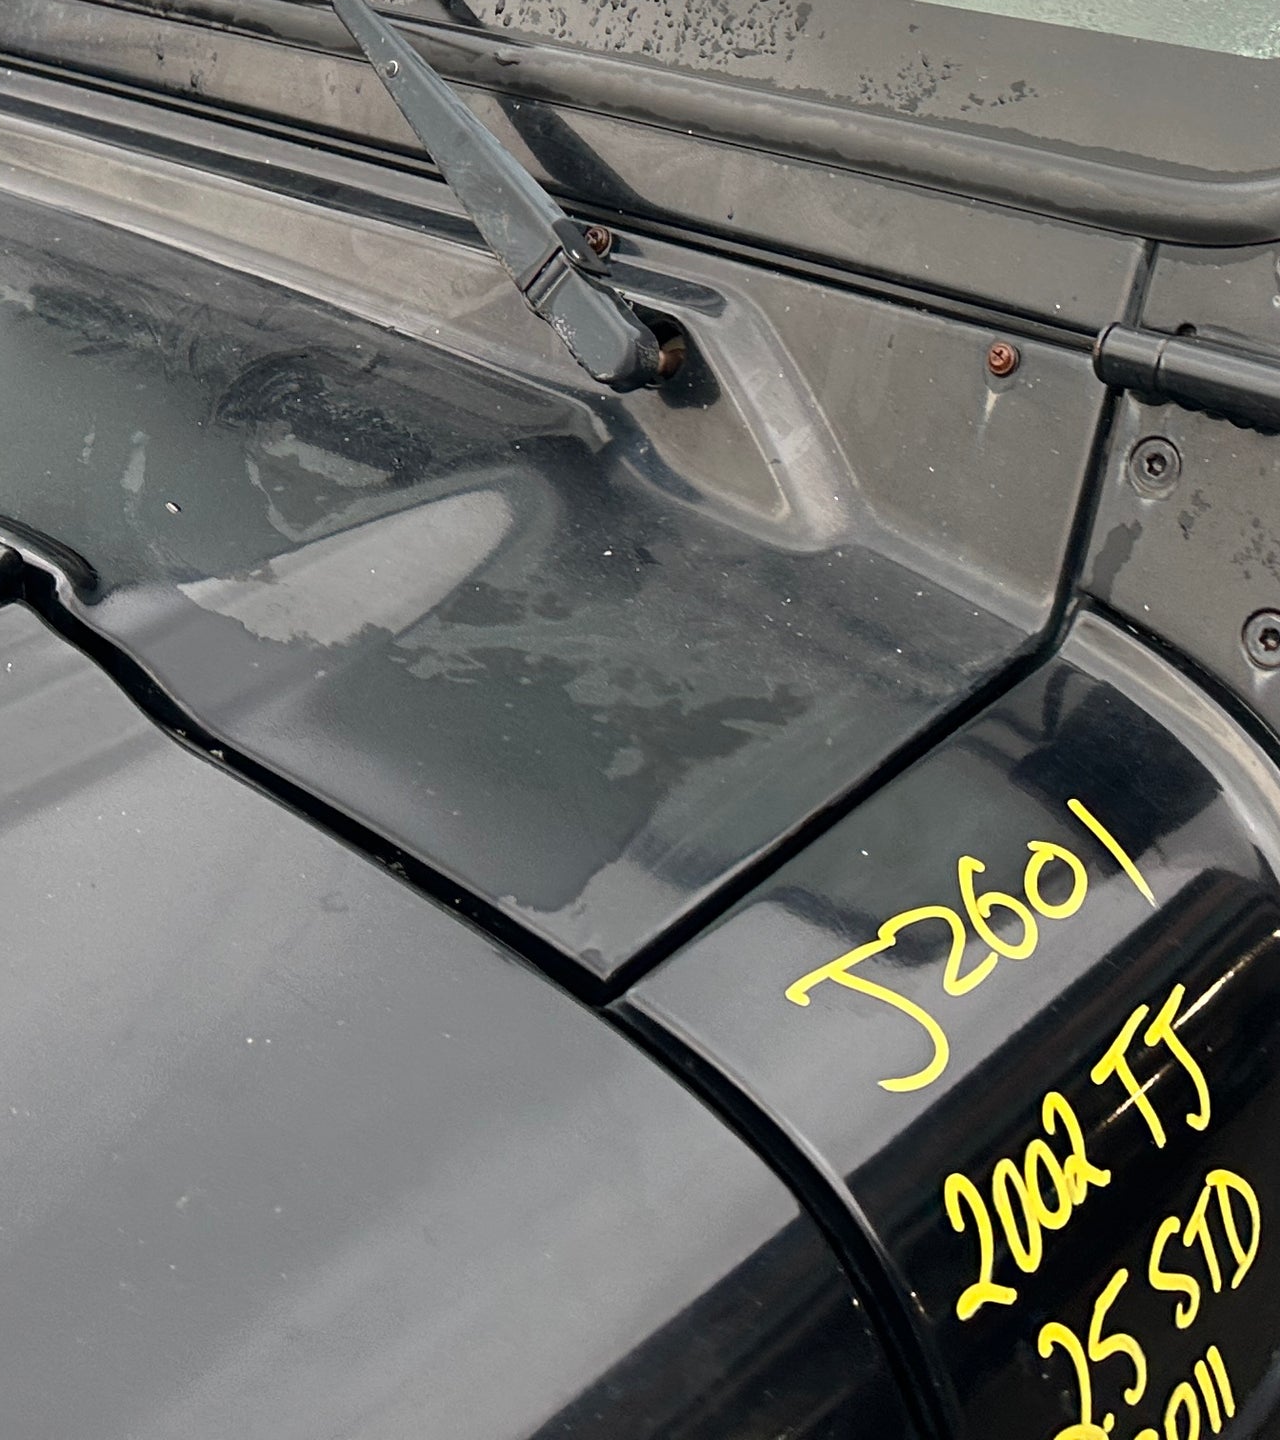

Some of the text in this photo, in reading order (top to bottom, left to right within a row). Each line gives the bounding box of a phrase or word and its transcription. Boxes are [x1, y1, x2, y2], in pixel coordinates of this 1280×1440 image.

[785, 798, 1158, 1093] J2601
[944, 984, 1211, 1321] 2002 TJ
[1148, 1170, 1261, 1329] STD
[1132, 1345, 1236, 1440] 011
